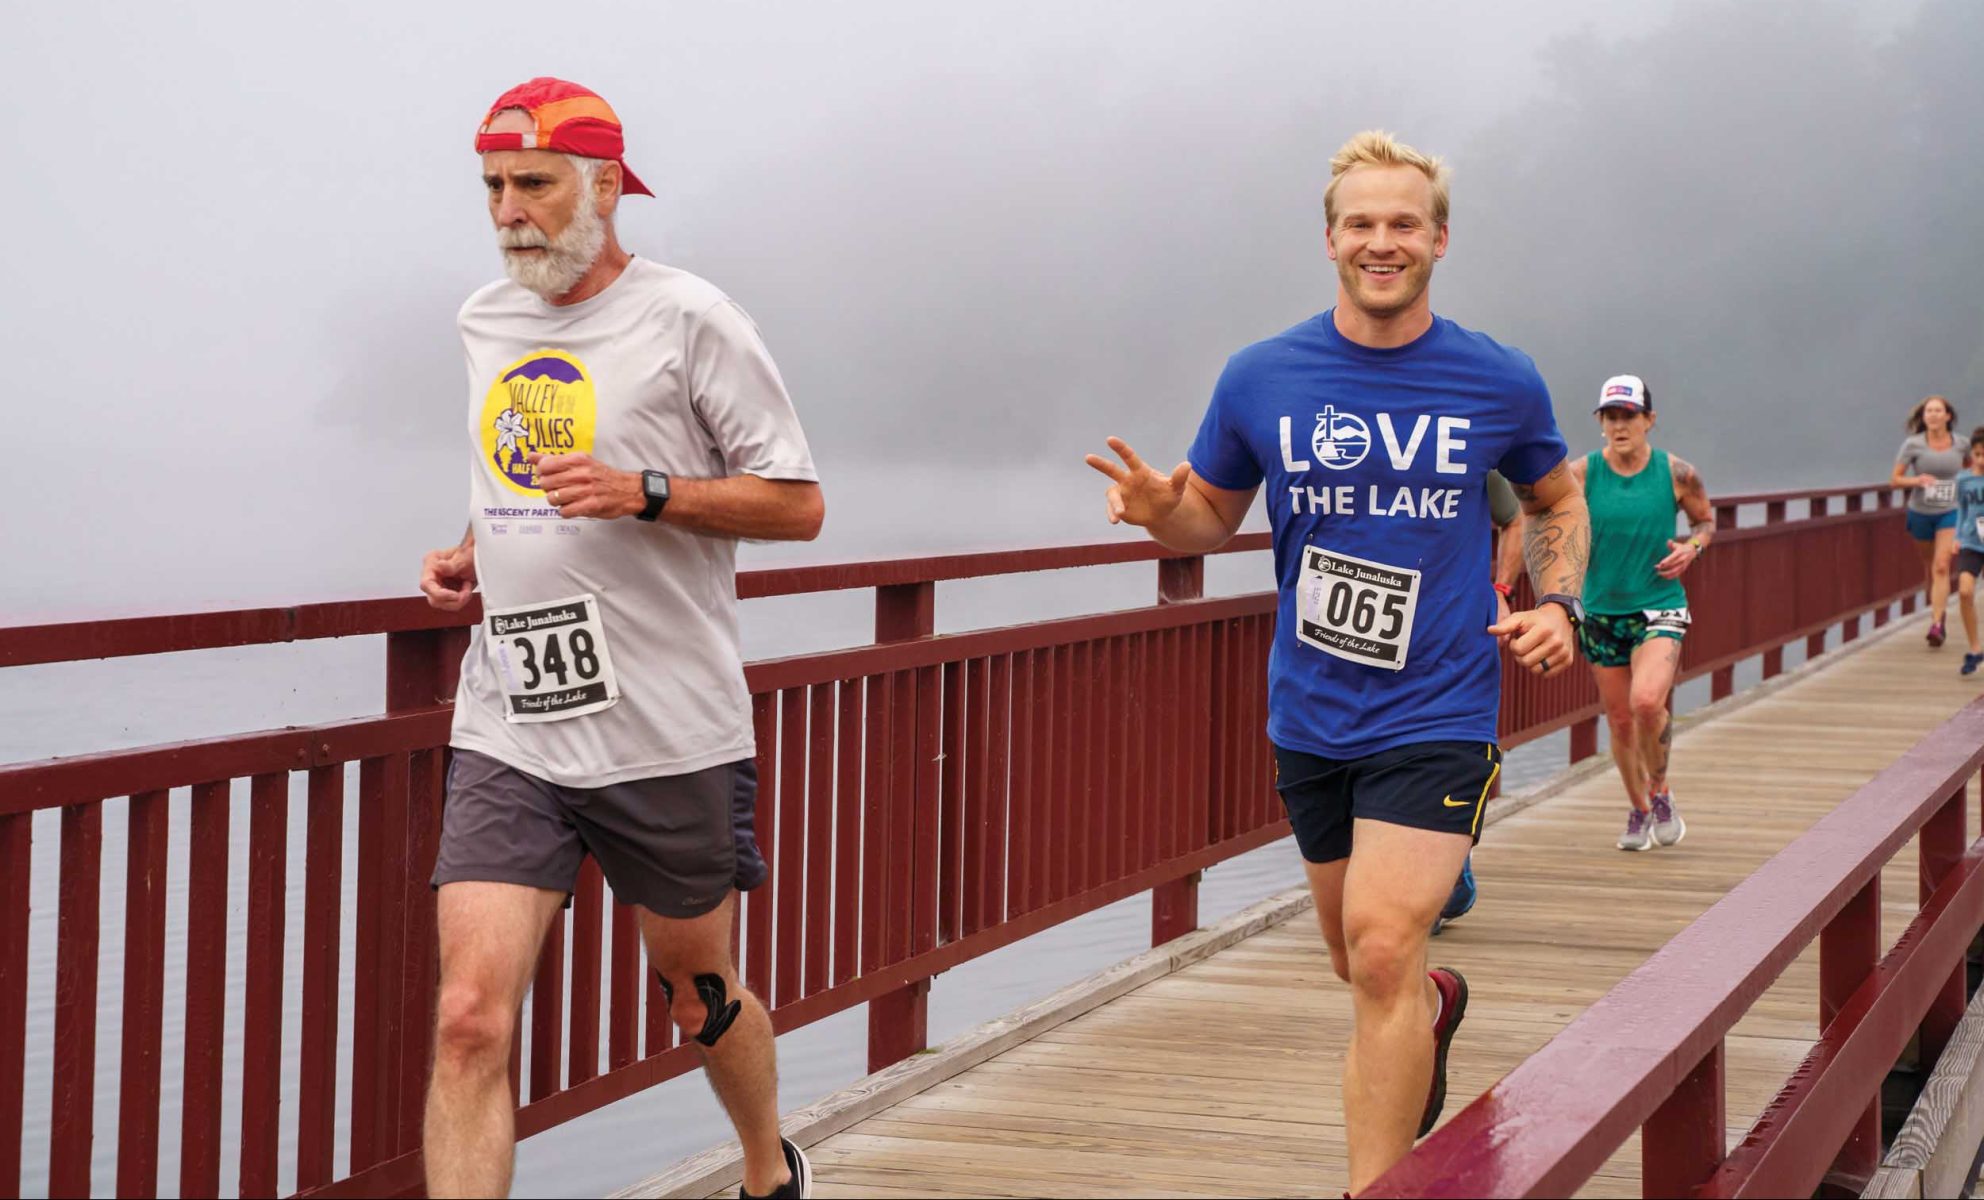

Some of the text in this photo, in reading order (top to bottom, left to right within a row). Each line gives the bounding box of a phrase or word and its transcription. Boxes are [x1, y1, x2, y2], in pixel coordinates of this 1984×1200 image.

[510, 384, 557, 413] VALLEY
[526, 418, 575, 449] LILIES
[1279, 405, 1471, 474] LOVE
[512, 463, 531, 474] HALF
[484, 508, 497, 517] THE
[1289, 485, 1463, 519] THE LAKE
[1331, 562, 1402, 587] Lake Junaluska
[505, 610, 577, 629] Lake Junaluska
[1326, 581, 1408, 640] 065
[1315, 628, 1380, 653] Friends of the Lake
[513, 628, 600, 690] 348
[543, 696, 551, 711] of
[551, 694, 563, 706] the
[564, 690, 587, 703] Lake
